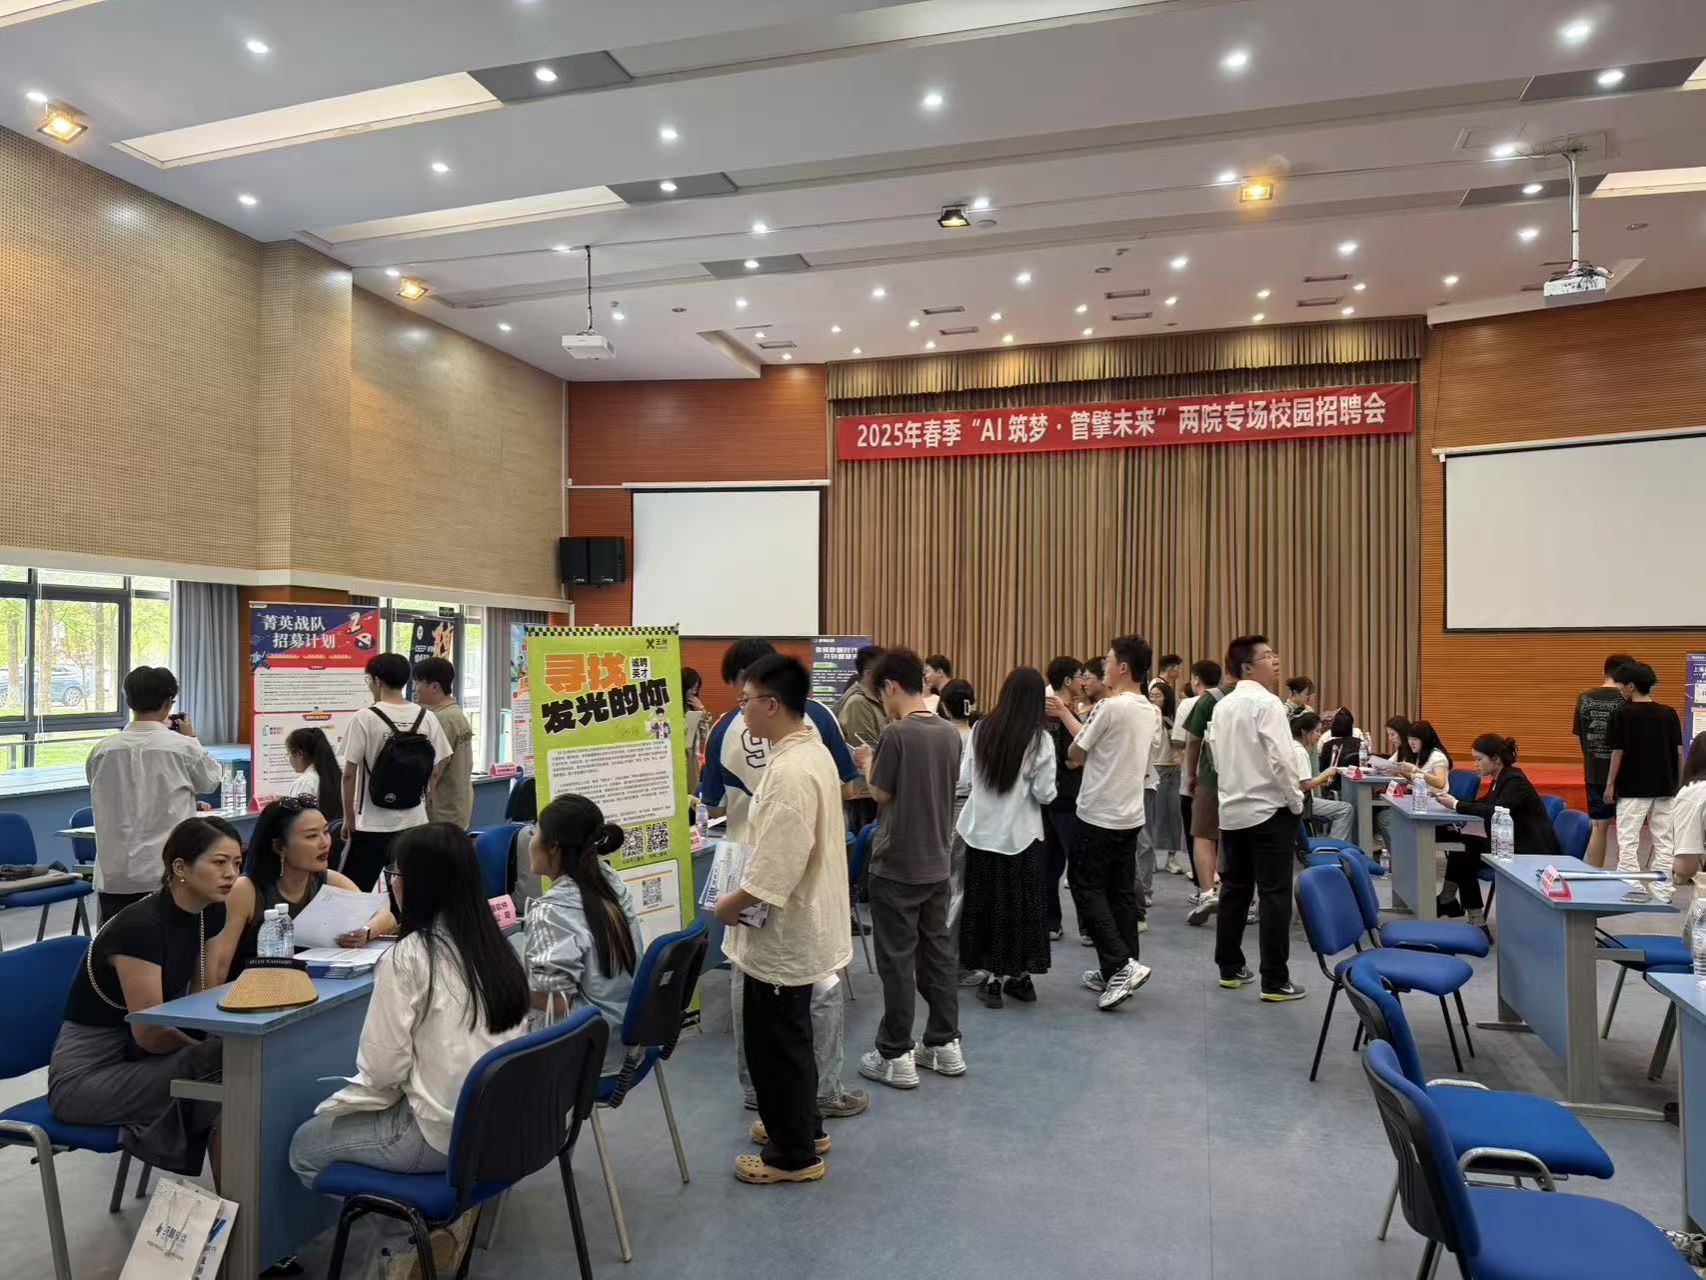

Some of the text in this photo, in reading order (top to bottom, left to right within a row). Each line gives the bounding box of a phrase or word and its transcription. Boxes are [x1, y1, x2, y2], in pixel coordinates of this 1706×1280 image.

[857, 418, 961, 449] 2025年春季
[1178, 392, 1387, 435] 两院专场校园招聘会
[262, 614, 326, 632] 菁英战队
[272, 632, 337, 649] 招募计划
[545, 652, 628, 693] 寻找
[631, 668, 649, 679] 英才
[541, 677, 671, 735] 发光的你
